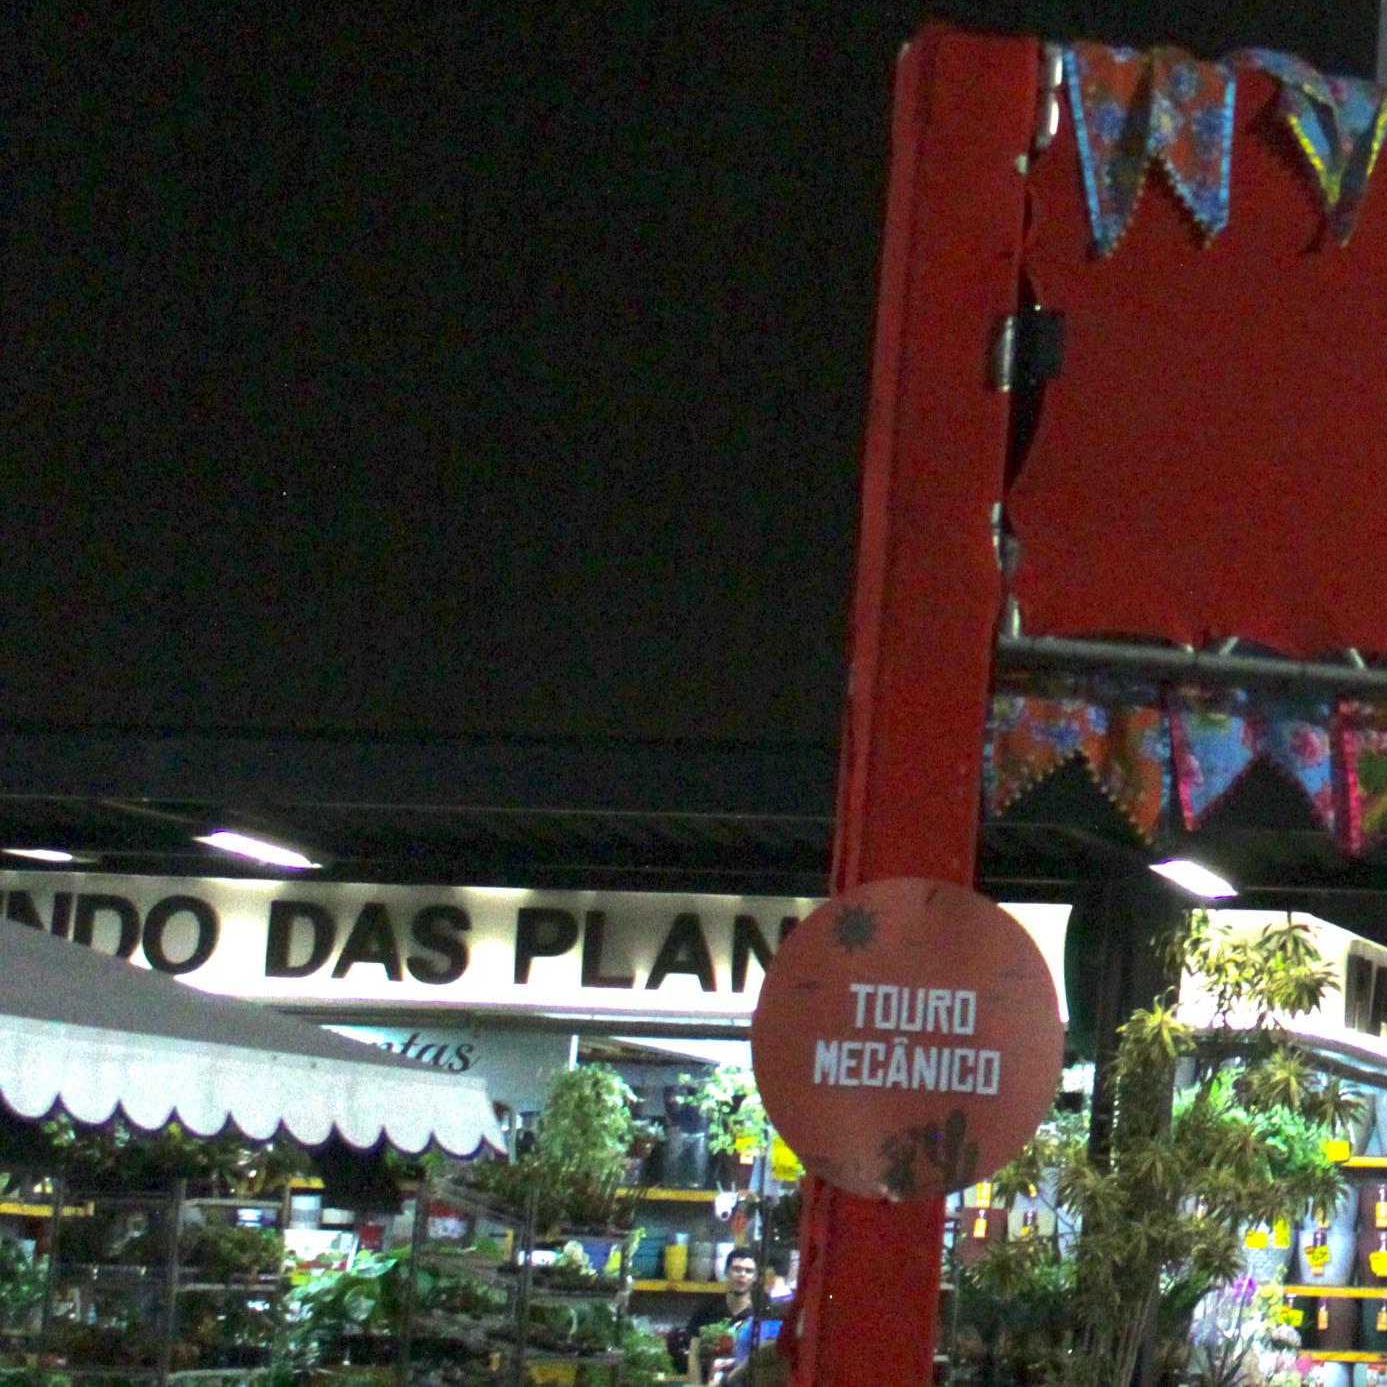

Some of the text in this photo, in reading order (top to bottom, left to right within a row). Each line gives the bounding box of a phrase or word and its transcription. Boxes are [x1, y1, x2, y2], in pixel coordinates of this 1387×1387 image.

[264, 899, 472, 987] DAS
[850, 982, 977, 1036] TOURO
[813, 1036, 1001, 1096] MECÂNICO
